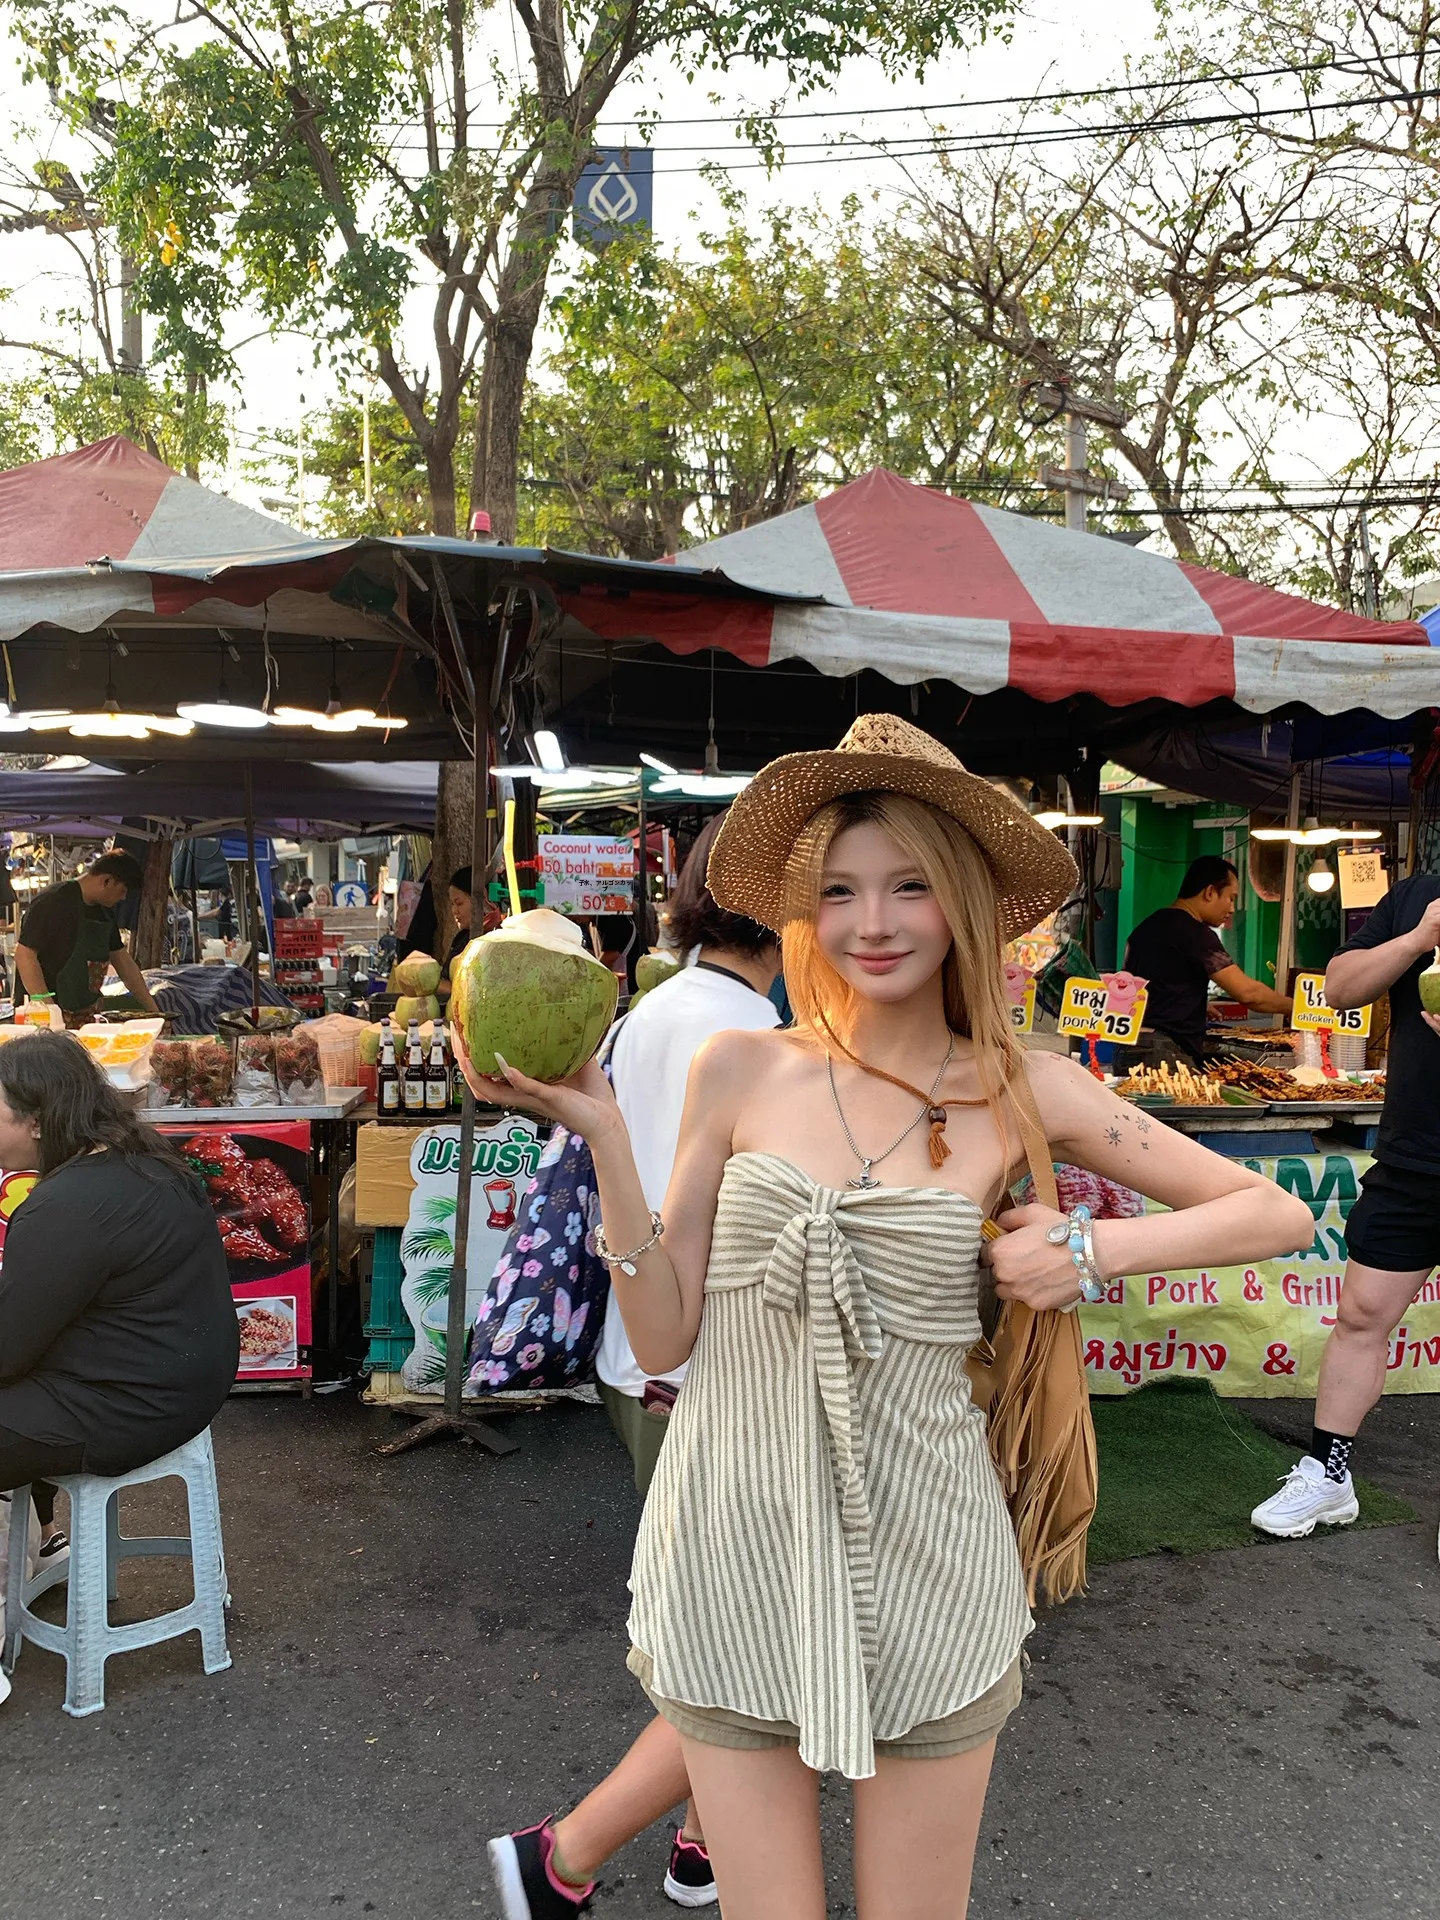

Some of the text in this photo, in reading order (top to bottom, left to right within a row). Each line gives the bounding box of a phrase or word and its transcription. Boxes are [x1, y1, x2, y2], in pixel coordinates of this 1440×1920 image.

[543, 841, 629, 855] Coconut water
[544, 860, 561, 874] 50
[565, 858, 595, 874] baht
[582, 895, 602, 910] 50
[1072, 988, 1107, 1017] หมู
[1011, 1007, 1025, 1026] 5
[1062, 1014, 1131, 1036] pork 15
[1297, 1009, 1362, 1029] chicken 15
[420, 1128, 542, 1177] มพร้า
[1147, 1272, 1219, 1306] Pork
[1243, 1269, 1264, 1302] &
[1282, 1272, 1341, 1306] Grill
[1084, 1327, 1440, 1385] หมูย่าง & ย่าง
